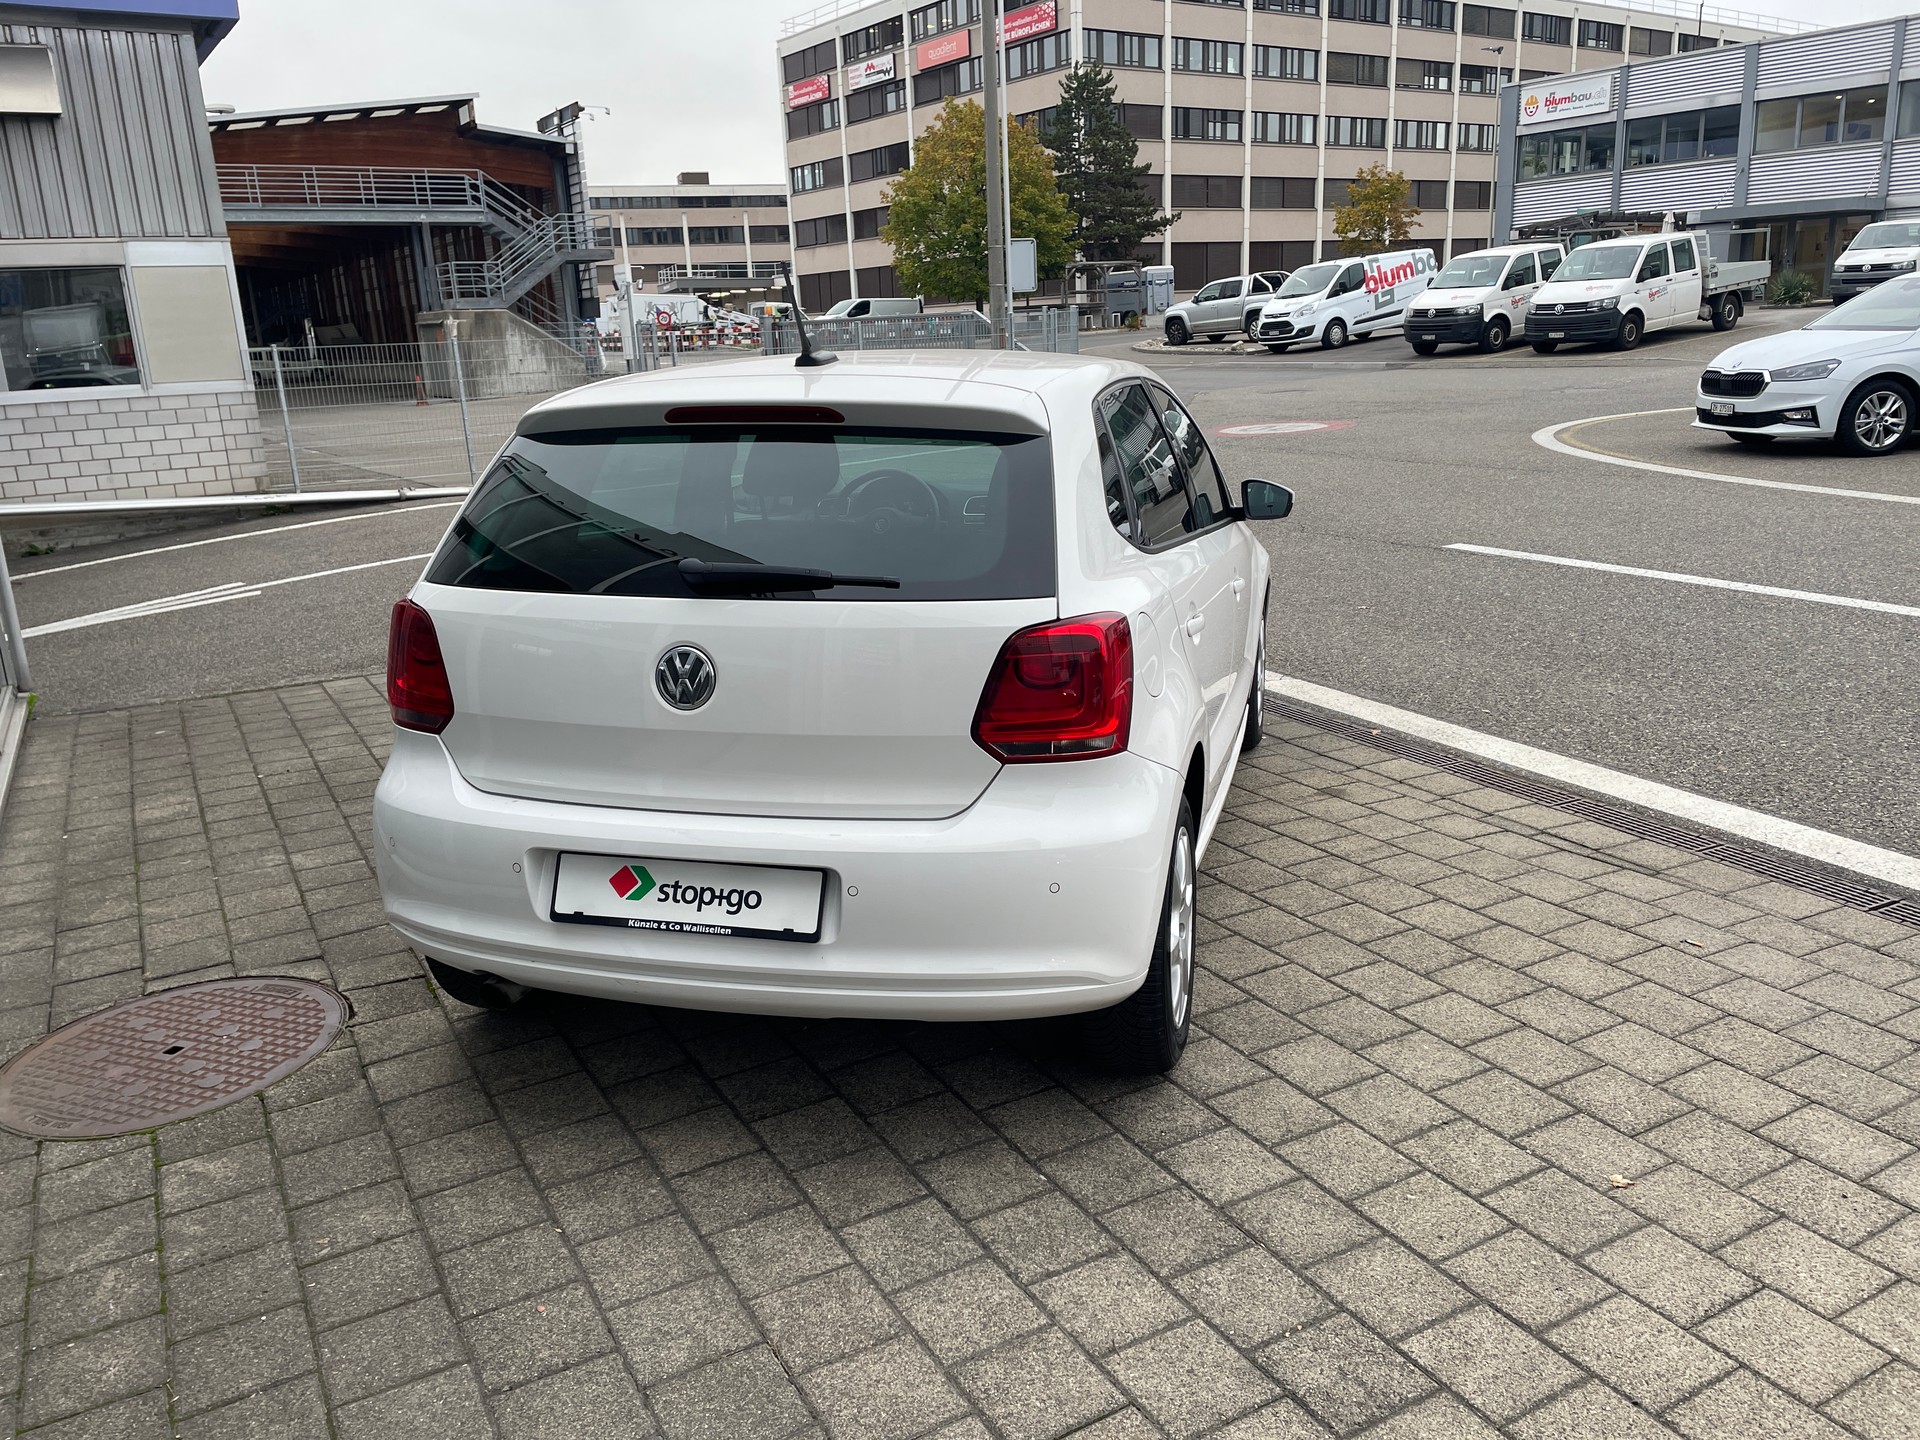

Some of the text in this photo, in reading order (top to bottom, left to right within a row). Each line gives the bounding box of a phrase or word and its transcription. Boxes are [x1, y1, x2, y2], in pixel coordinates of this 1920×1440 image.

[1544, 87, 1607, 107] blumbau.ch
[657, 880, 762, 915] stop+go
[628, 919, 732, 935] Künzle & Co Wallisellen
